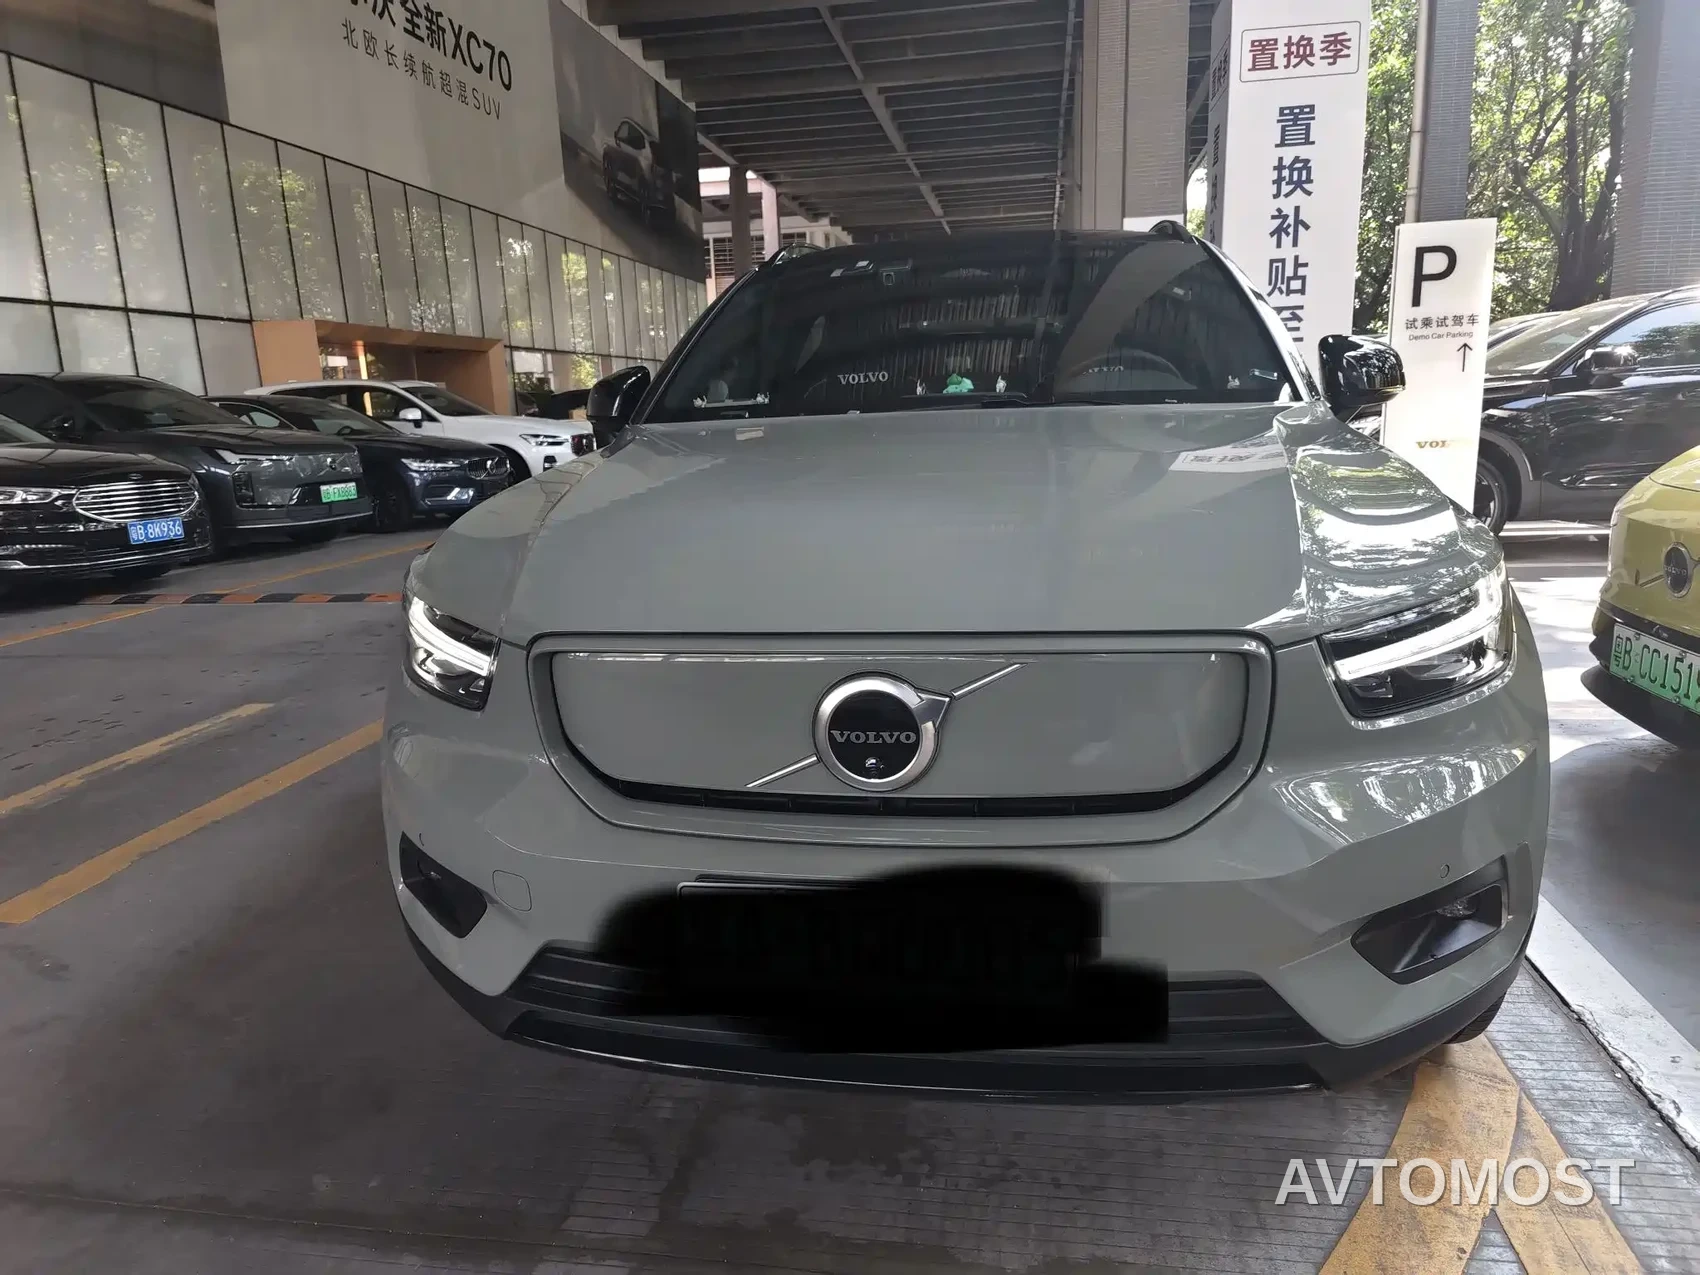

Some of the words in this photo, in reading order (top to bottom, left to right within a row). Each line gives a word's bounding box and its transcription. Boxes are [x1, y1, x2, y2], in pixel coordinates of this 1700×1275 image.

[351, 0, 511, 91] 全新XC70
[1248, 31, 1352, 72] 置换季
[342, 17, 501, 120] 北欧长续航超混SUV
[1411, 245, 1457, 308] P
[1405, 313, 1479, 330] 试乘试驾车
[1408, 333, 1430, 341] Demo
[1446, 331, 1474, 339] Parking
[837, 371, 889, 385] VOLVO
[1416, 440, 1452, 449] VOL
[830, 730, 917, 744] VOLVO
